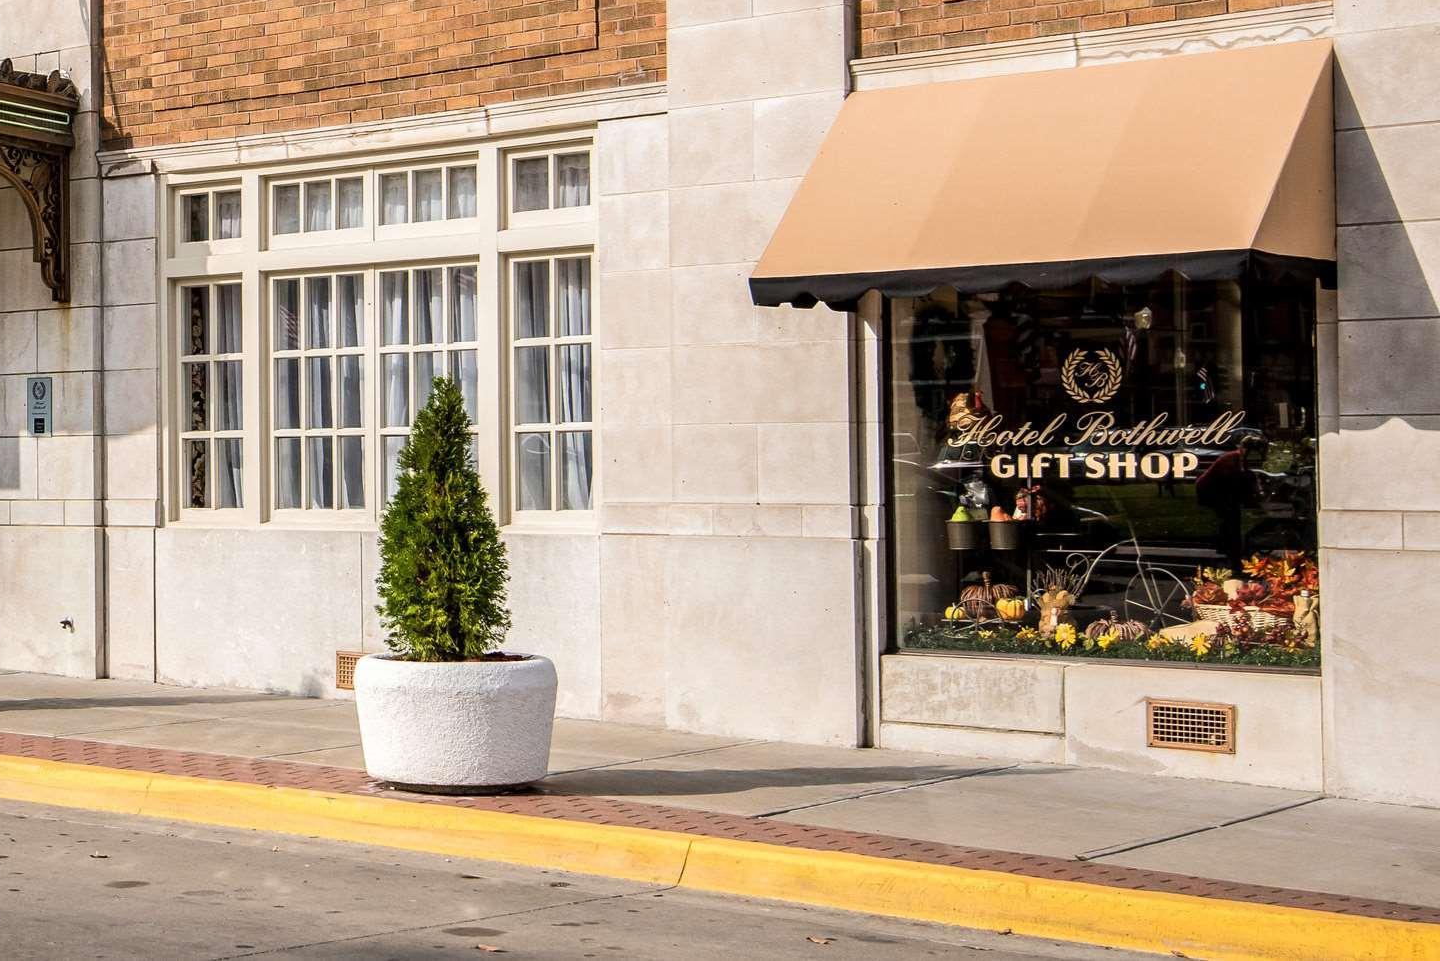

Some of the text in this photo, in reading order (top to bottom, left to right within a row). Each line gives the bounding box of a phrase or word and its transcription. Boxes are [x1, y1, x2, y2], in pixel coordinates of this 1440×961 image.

[947, 410, 1247, 448] Hotel Bothwell
[990, 452, 1199, 479] GIFT SHOP
